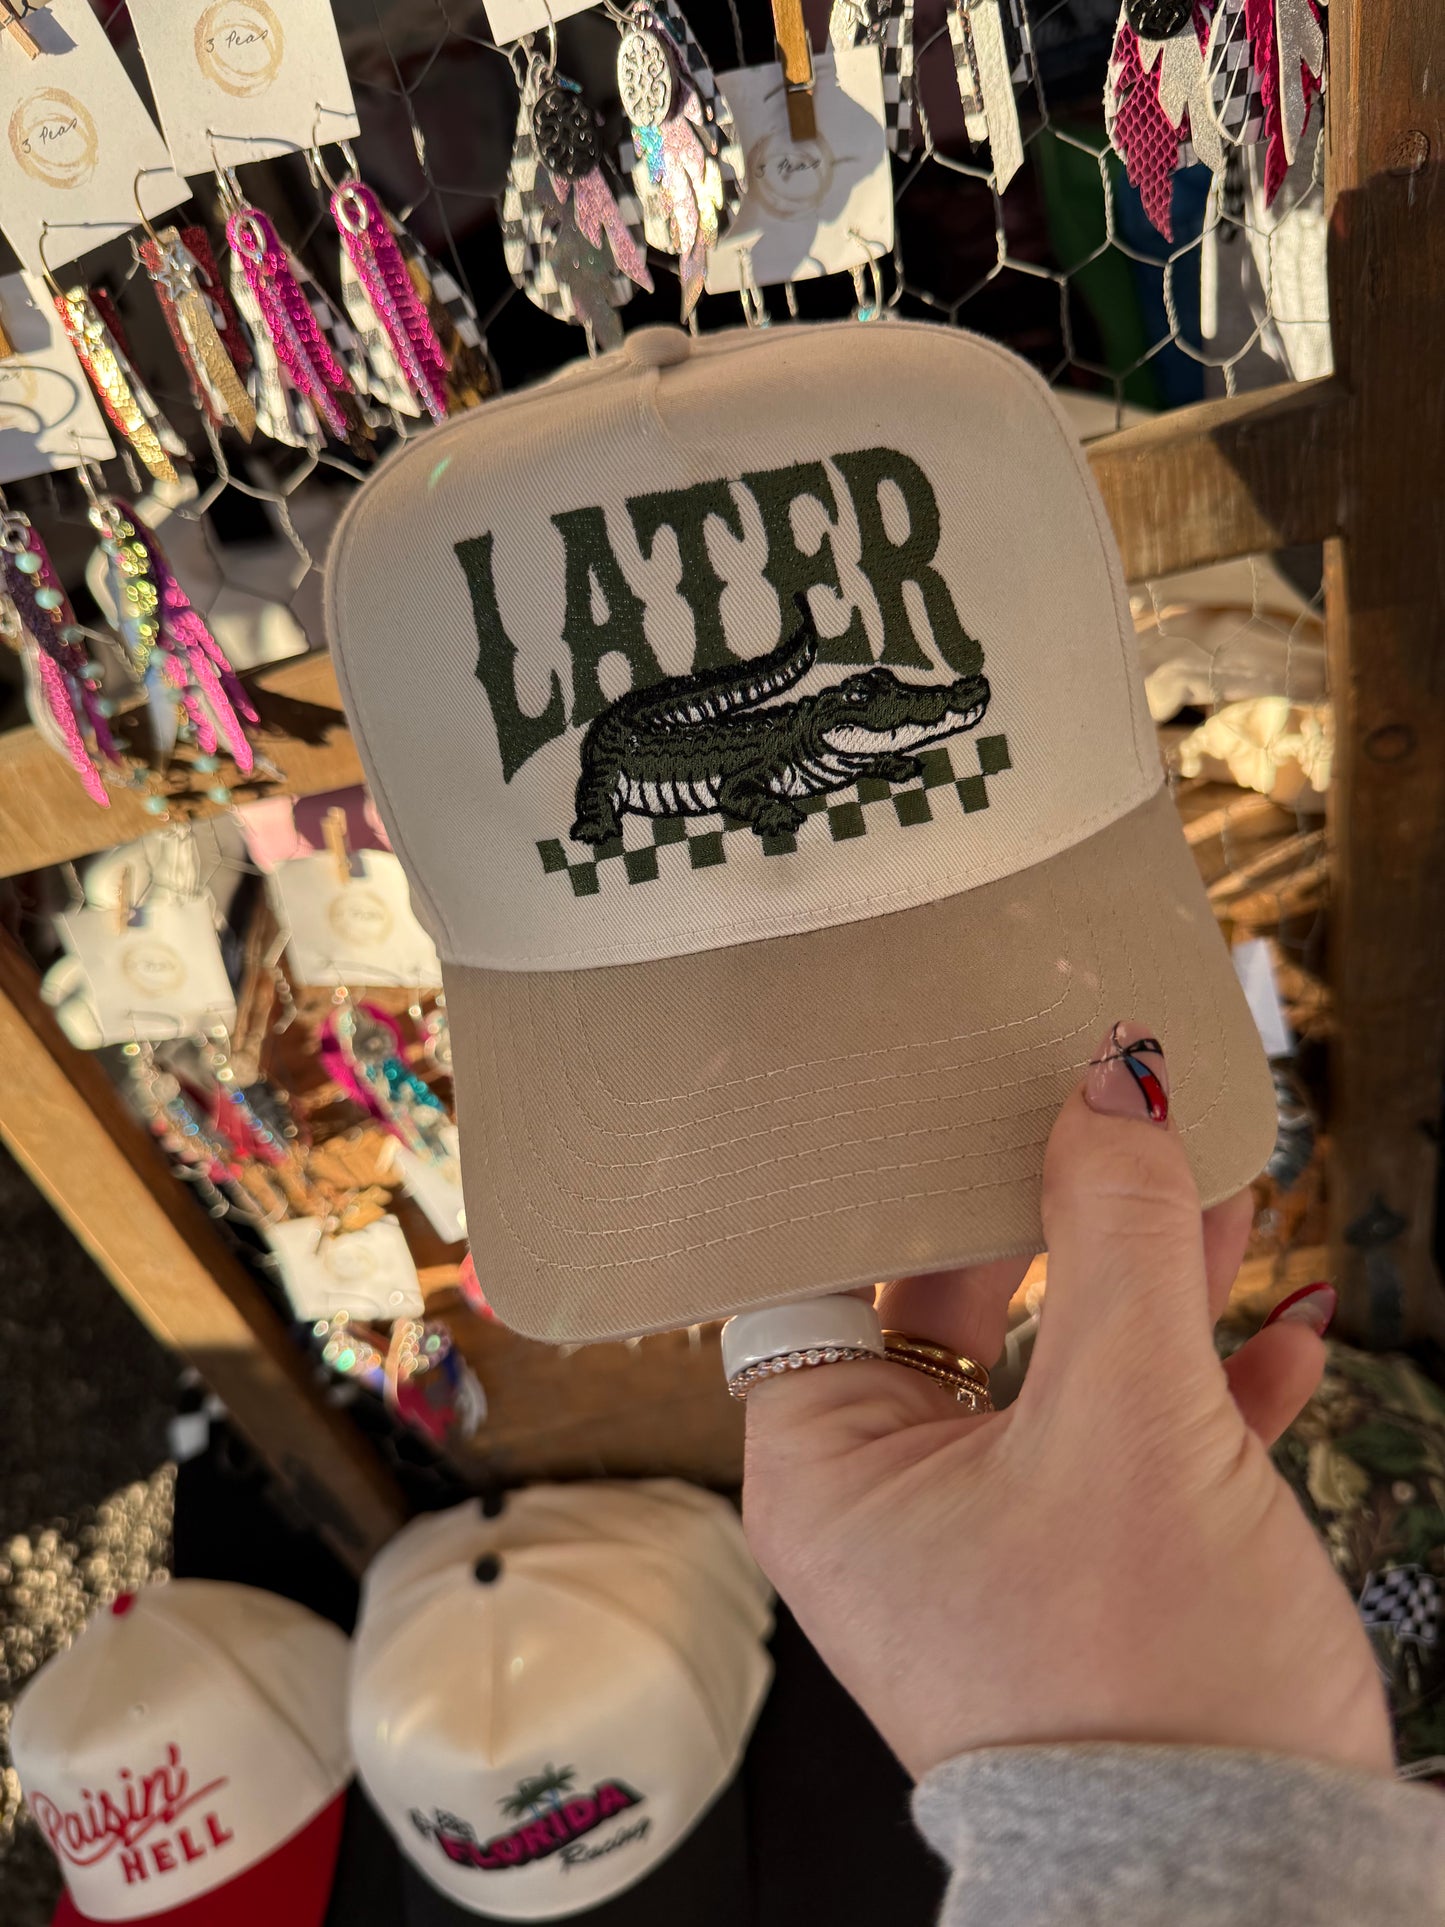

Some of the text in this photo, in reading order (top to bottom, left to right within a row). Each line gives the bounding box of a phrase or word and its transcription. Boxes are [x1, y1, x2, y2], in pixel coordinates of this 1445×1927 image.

[206, 29, 269, 53] 3 Peas
[21, 117, 78, 154] 3 Peas
[453, 447, 985, 784] LATER
[119, 1811, 234, 1884] HELL
[435, 1778, 644, 1871] FLORIDA
